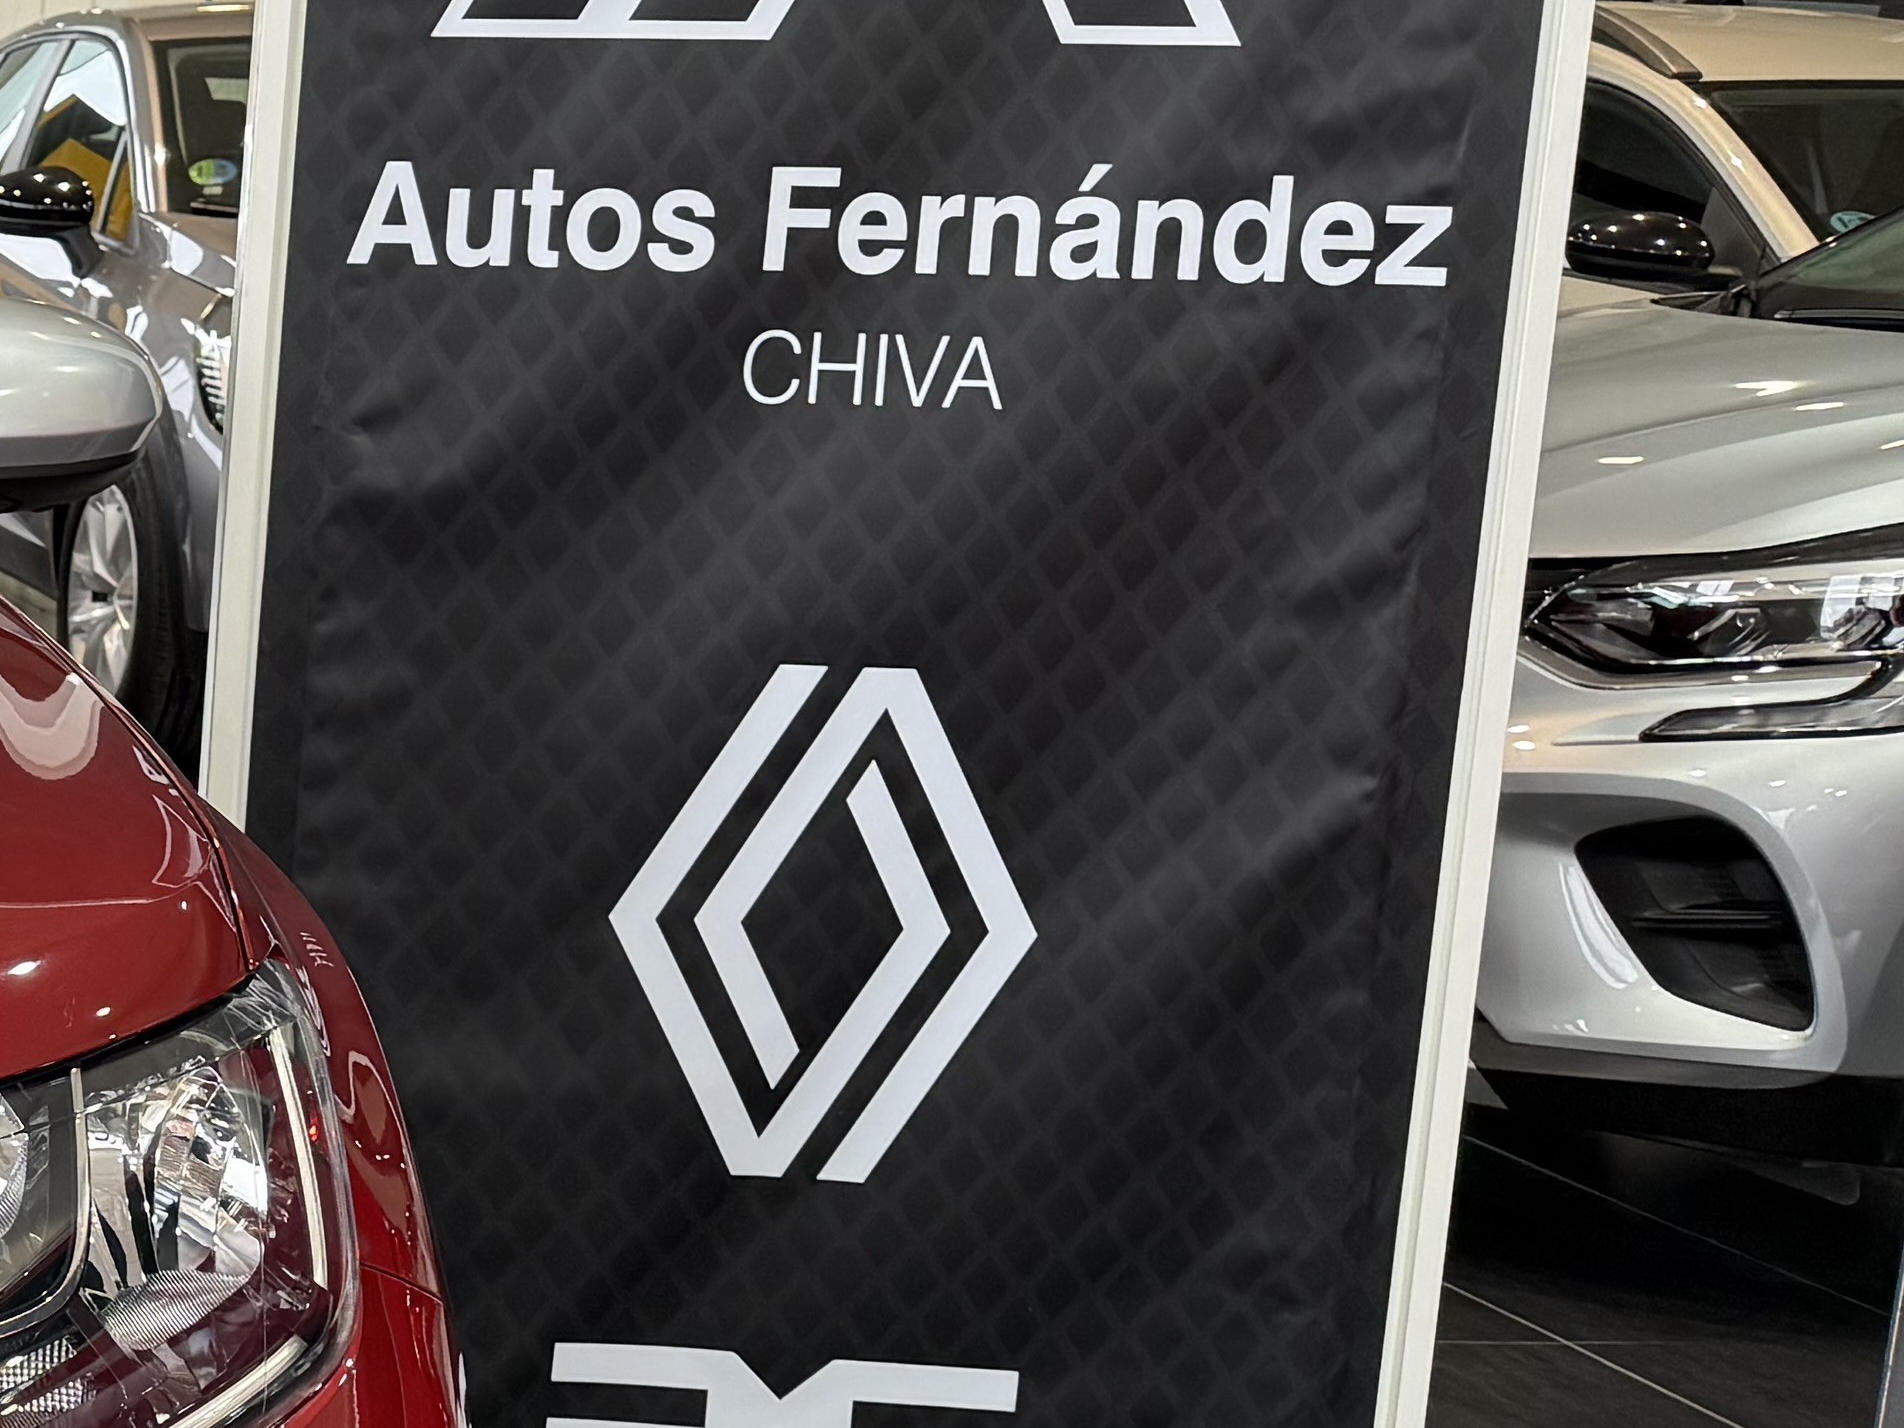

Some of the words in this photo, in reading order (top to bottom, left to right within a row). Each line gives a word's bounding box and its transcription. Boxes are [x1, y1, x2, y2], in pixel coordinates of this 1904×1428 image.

[346, 160, 716, 272] Autos
[762, 163, 1454, 287] Fernández
[742, 329, 1003, 410] CHIVA
